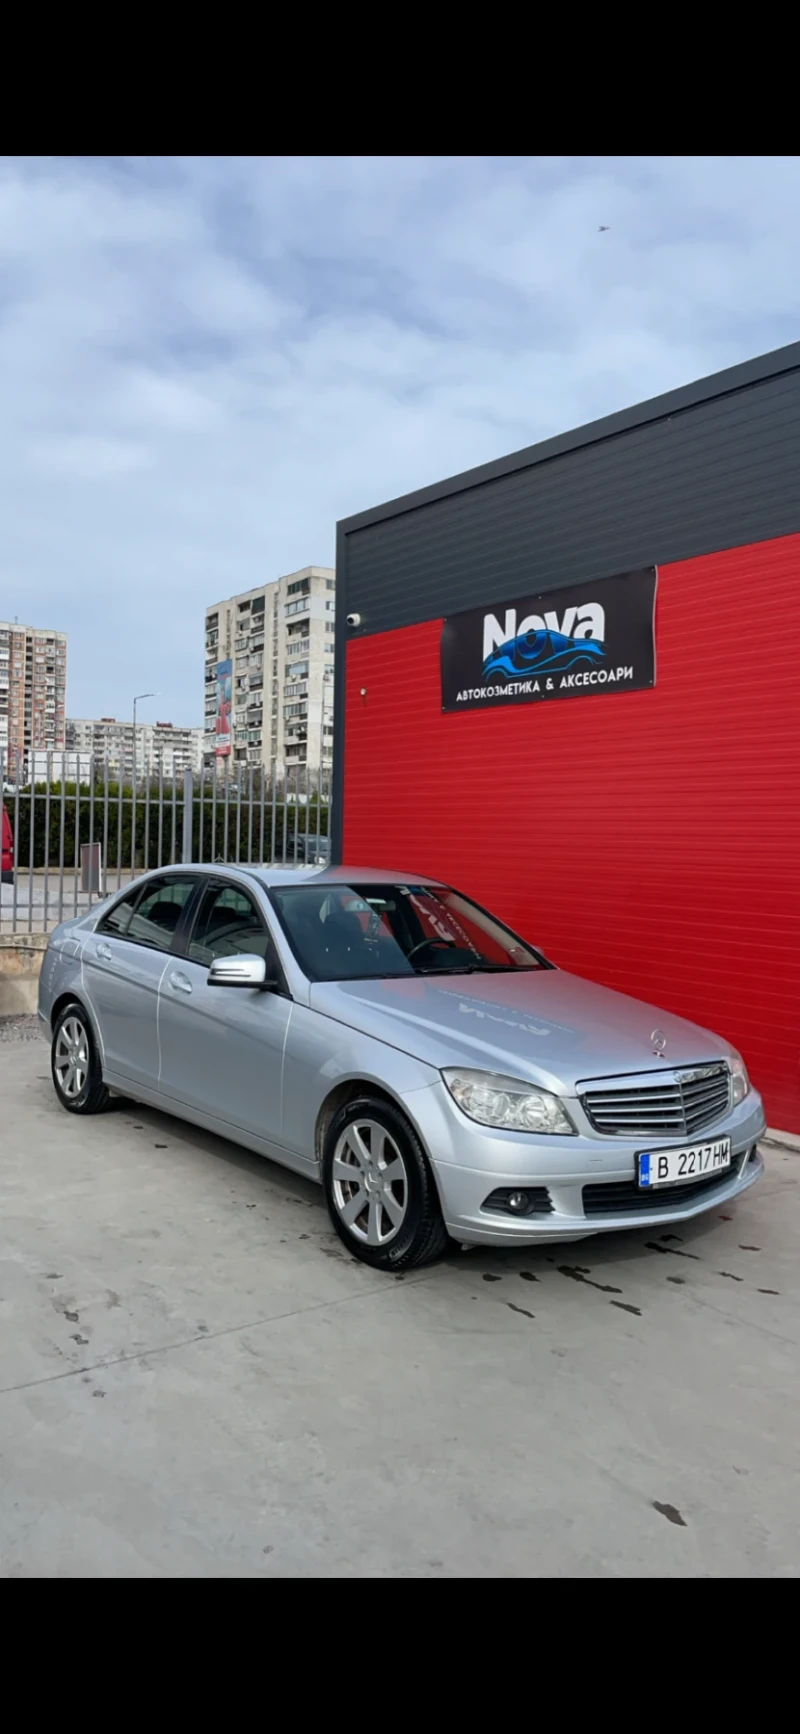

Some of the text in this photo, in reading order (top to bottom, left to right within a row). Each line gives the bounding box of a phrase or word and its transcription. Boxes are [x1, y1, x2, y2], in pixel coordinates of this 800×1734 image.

[483, 602, 605, 662] Nova
[456, 666, 634, 702] АВТОКОЗМЕТИКА & АКСЕСОАРИ
